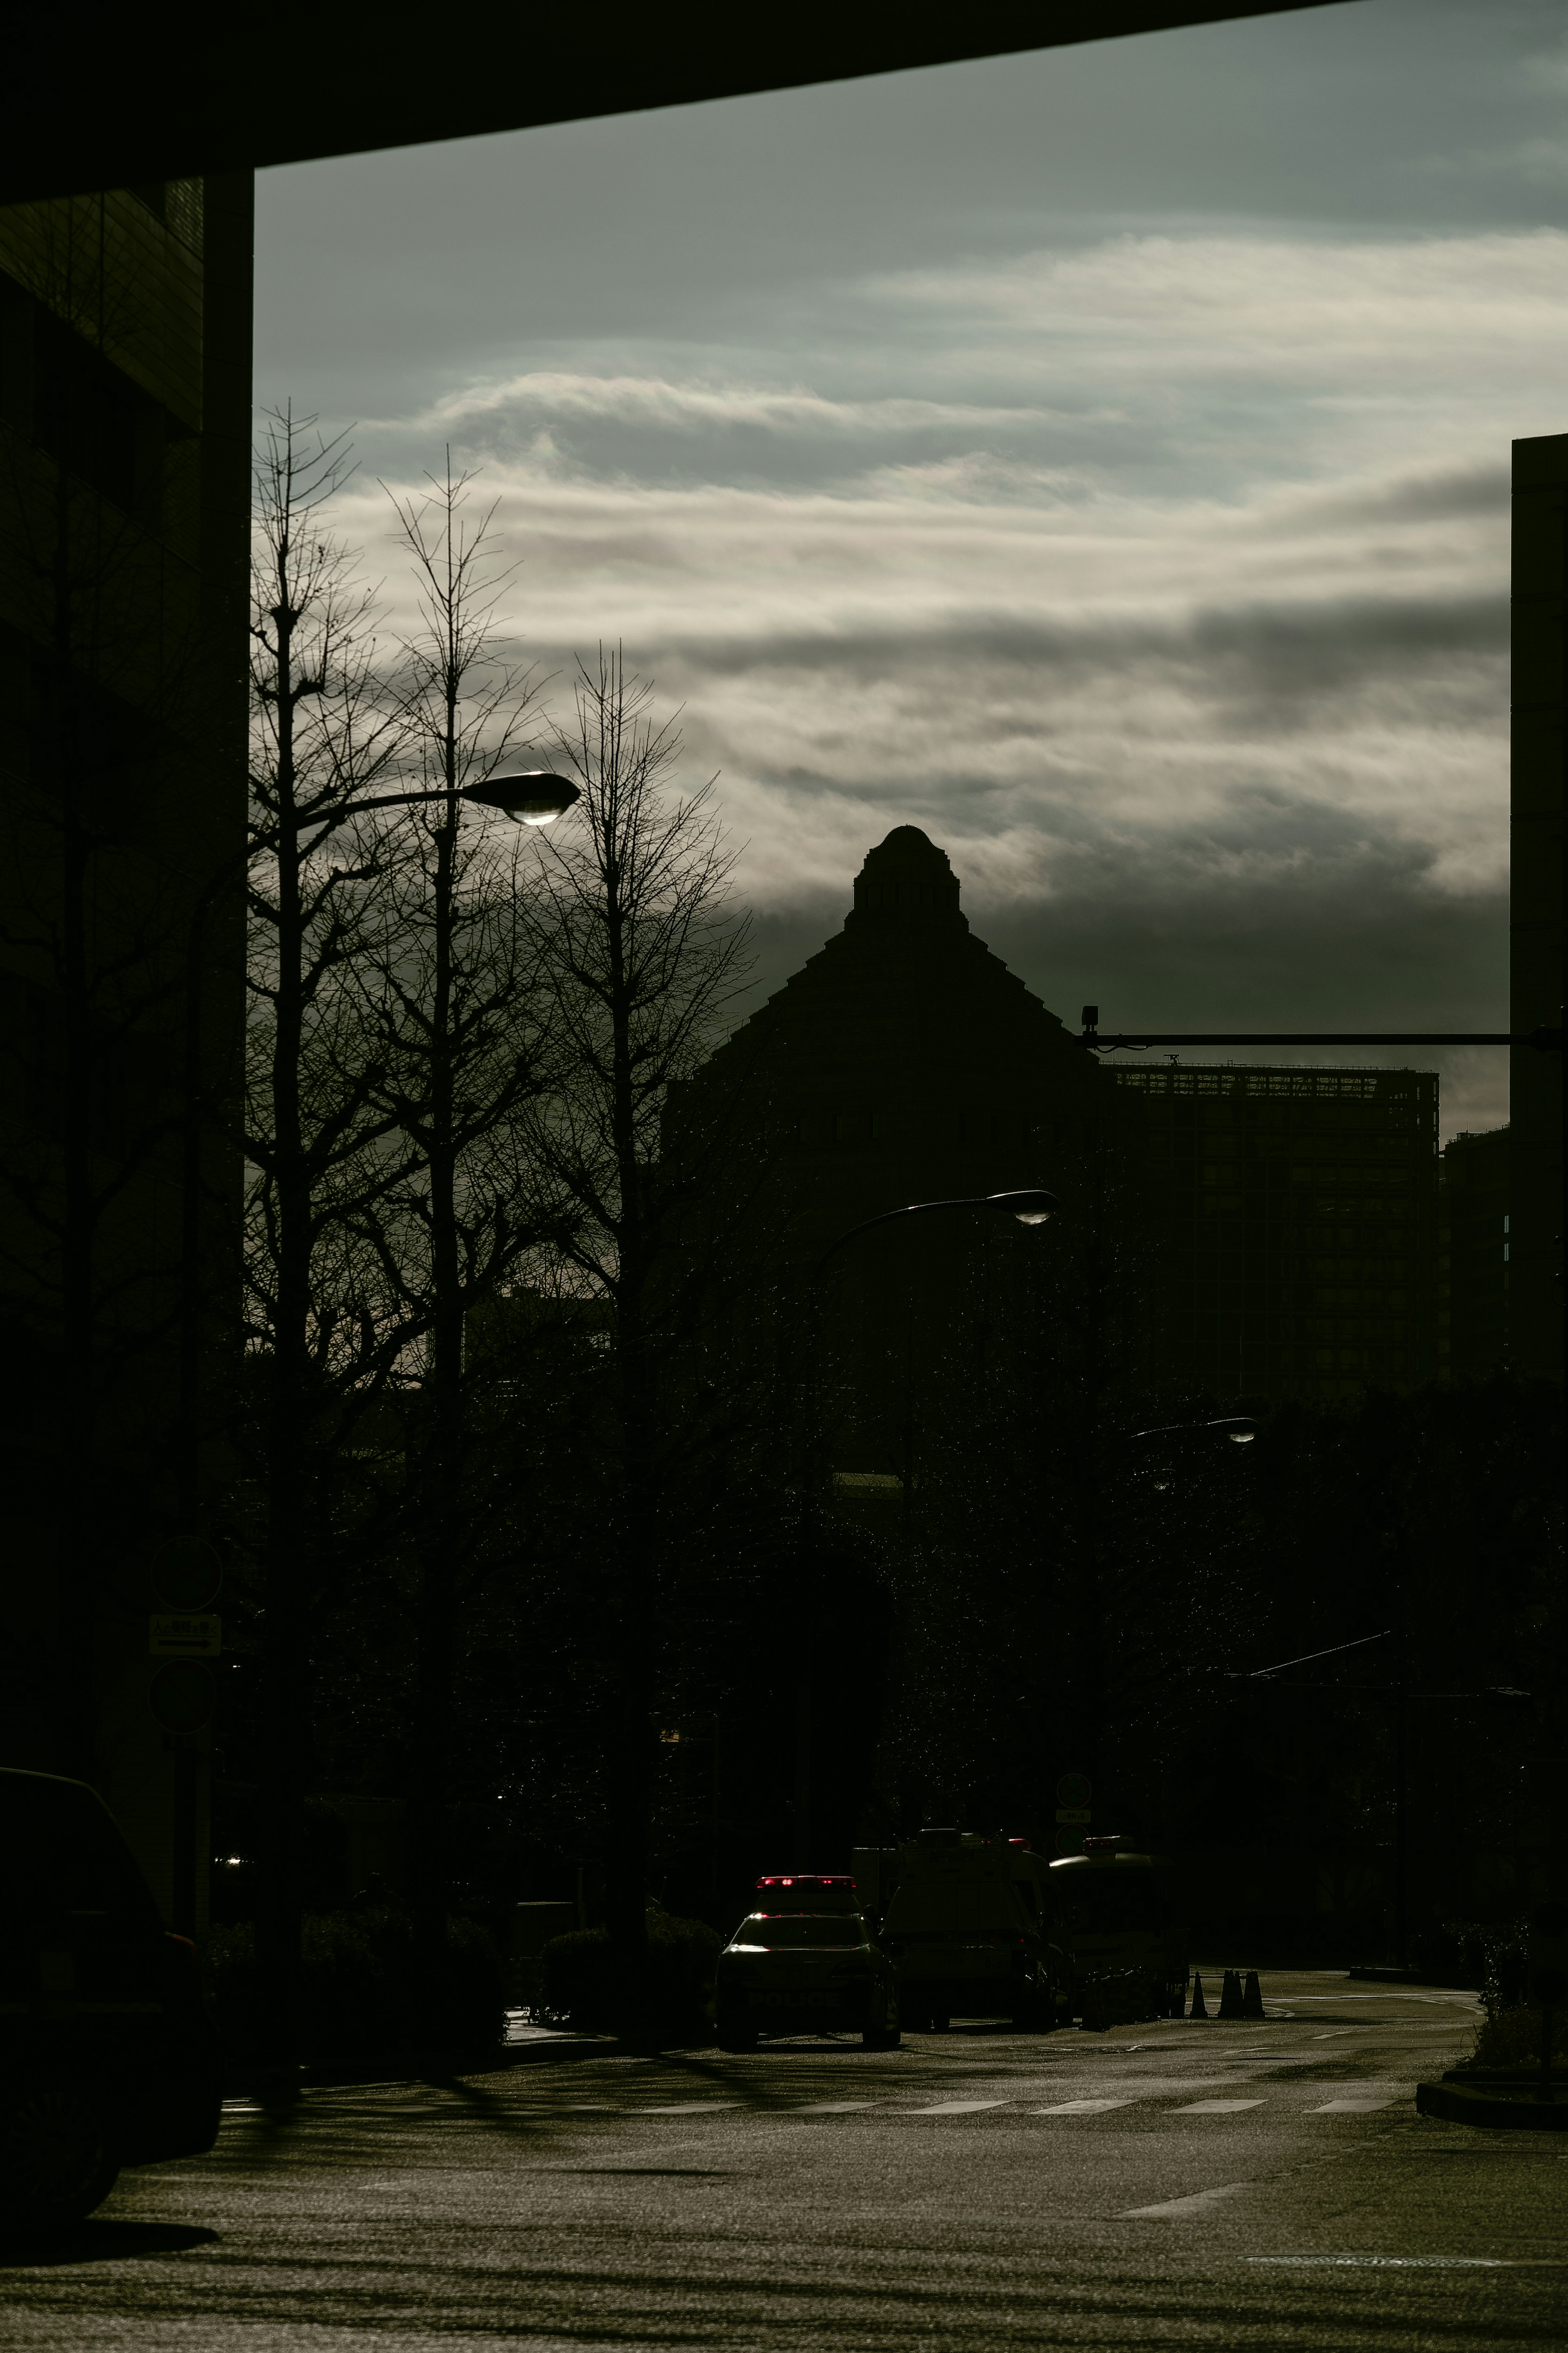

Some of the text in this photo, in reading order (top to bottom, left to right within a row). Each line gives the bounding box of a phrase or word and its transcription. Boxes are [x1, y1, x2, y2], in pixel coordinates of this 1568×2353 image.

[176, 1539, 200, 1549] 8-18
[153, 1620, 218, 1635] 人の乗降を除く
[749, 1992, 840, 2007] POLICE
